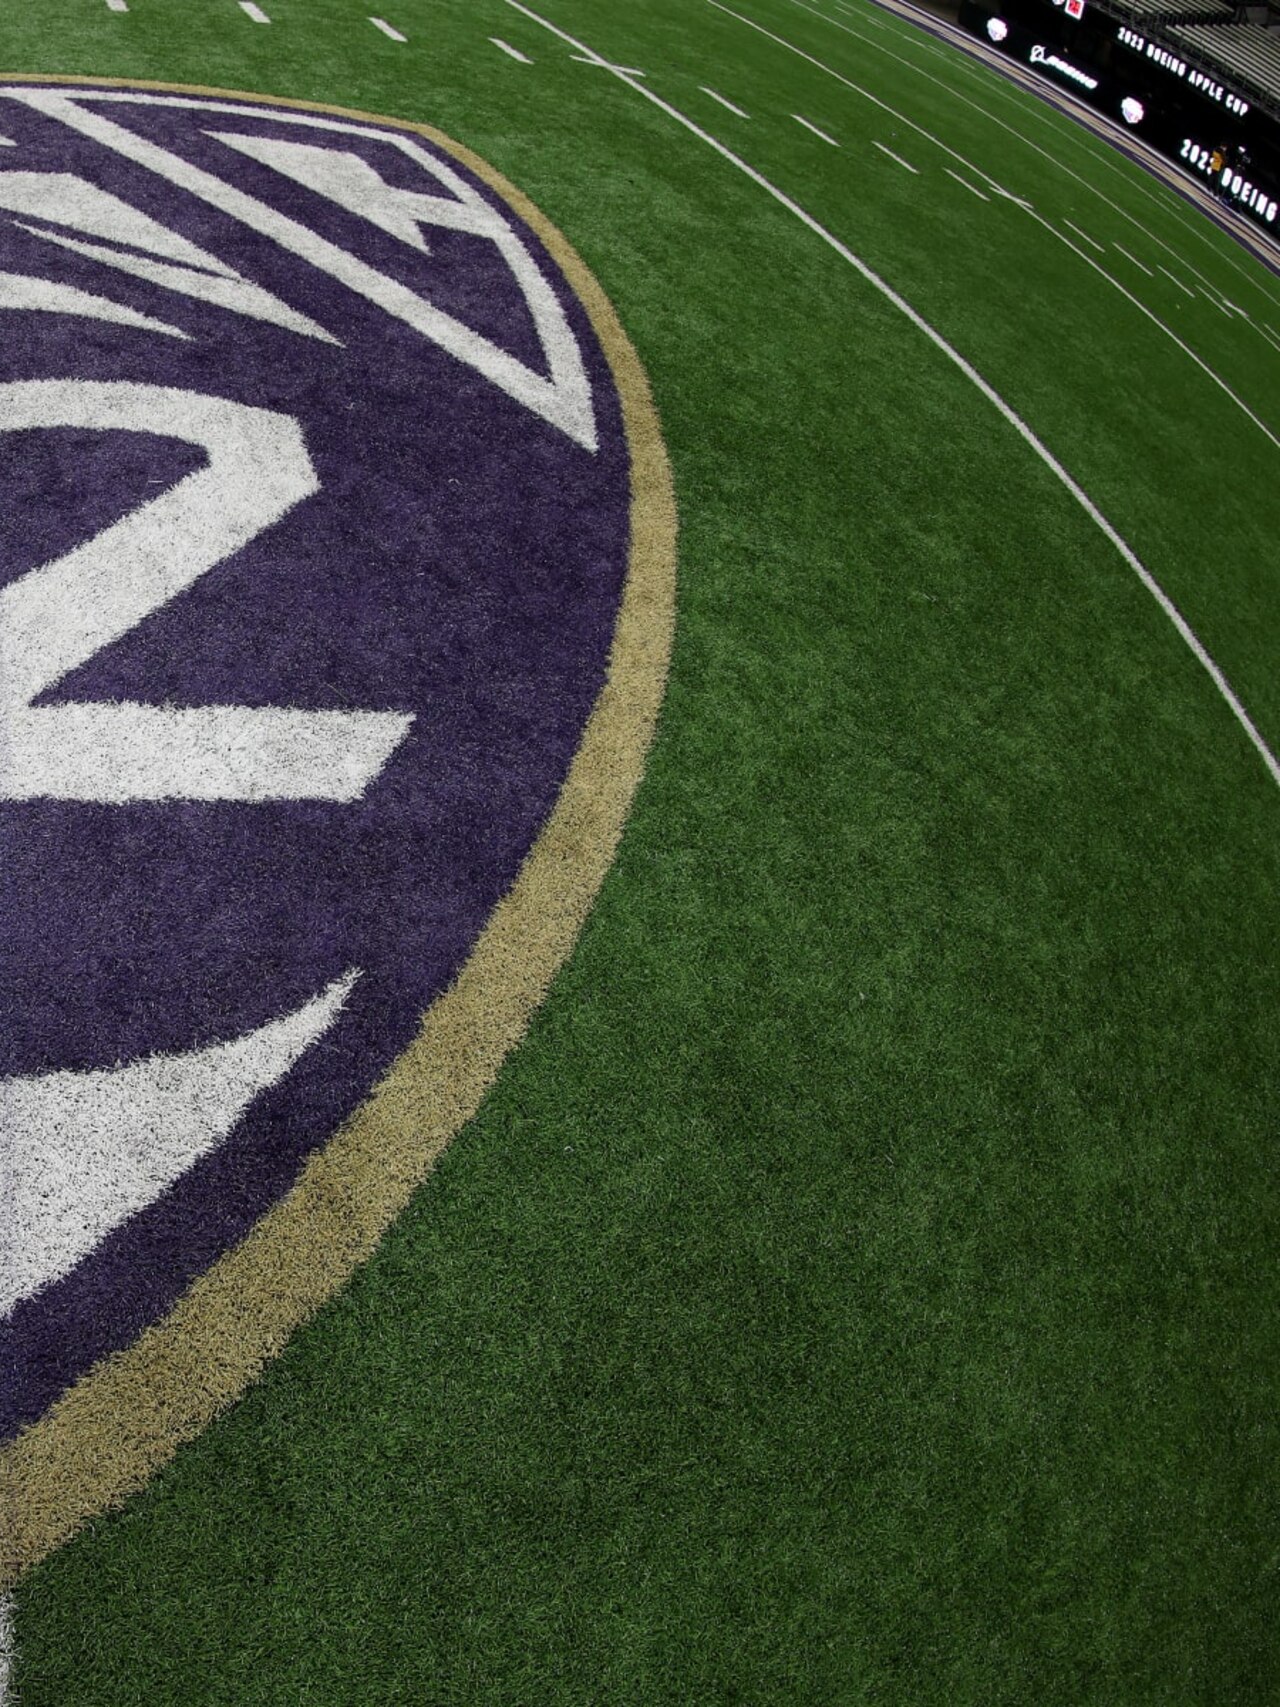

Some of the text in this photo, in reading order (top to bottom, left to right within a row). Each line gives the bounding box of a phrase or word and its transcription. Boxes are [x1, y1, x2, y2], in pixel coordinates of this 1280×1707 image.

[1118, 26, 1249, 116] 2023 BOEING APPLE CUP
[1221, 167, 1278, 222] BOEING
